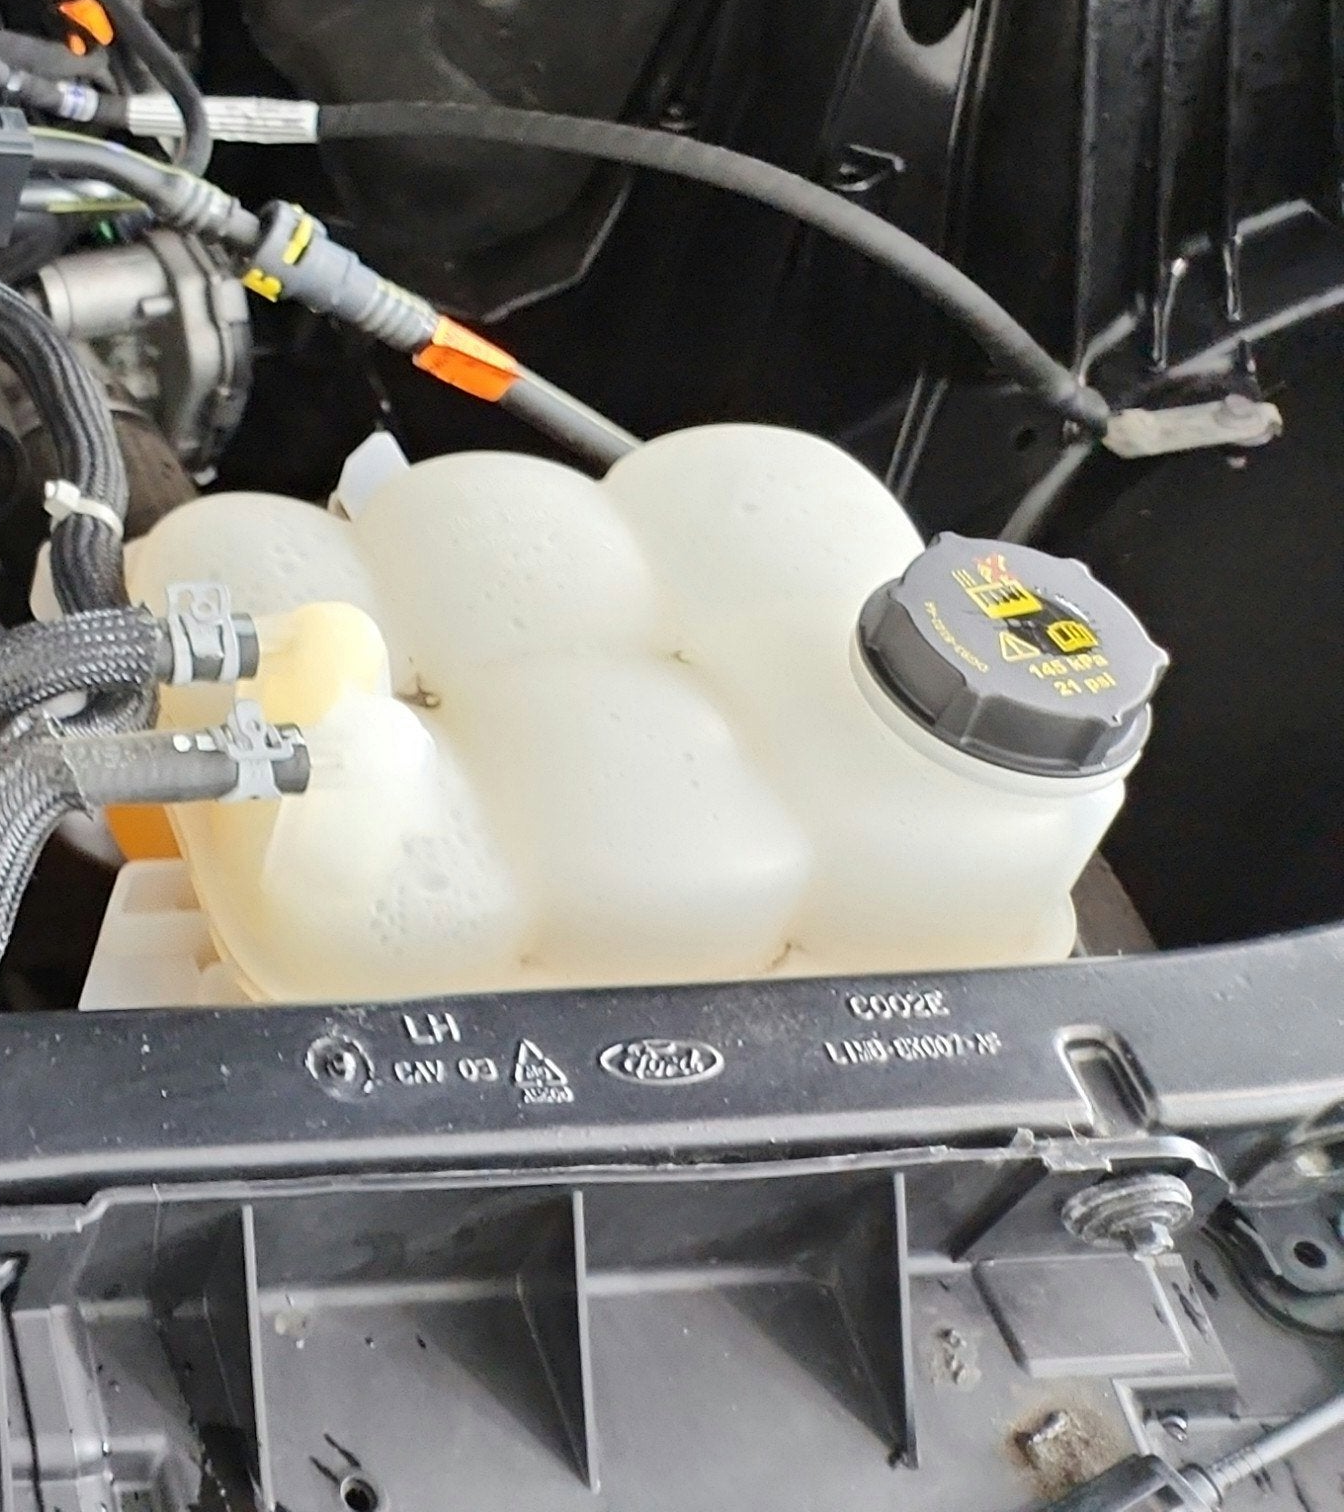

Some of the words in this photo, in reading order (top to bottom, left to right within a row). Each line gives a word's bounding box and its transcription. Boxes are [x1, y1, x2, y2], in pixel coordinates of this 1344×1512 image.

[1029, 659, 1068, 679] 145
[1065, 653, 1109, 672] kPa
[1053, 679, 1082, 697] 21
[1083, 671, 1117, 694] psi
[403, 1012, 461, 1045] LH
